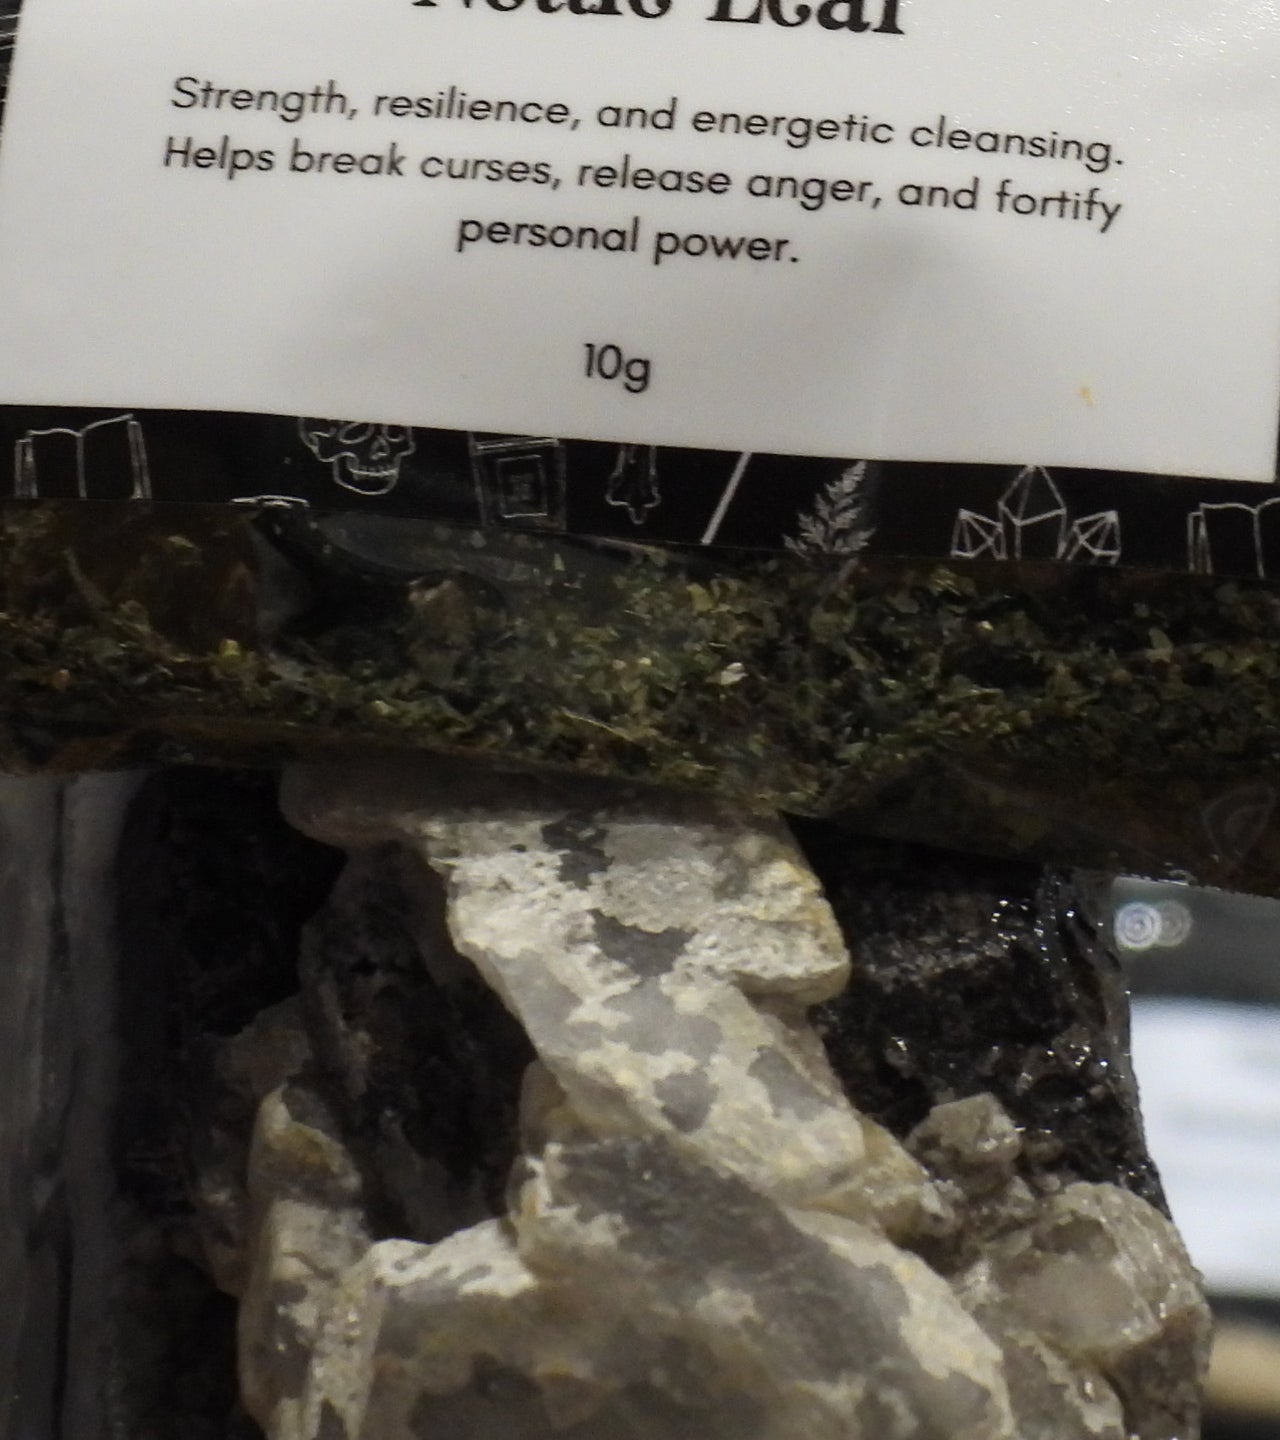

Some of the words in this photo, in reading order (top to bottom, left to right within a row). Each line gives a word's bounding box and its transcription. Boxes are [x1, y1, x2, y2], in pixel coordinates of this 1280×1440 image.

[170, 76, 359, 123] Strength,
[372, 86, 582, 127] resilience,
[596, 98, 678, 133] and
[690, 107, 896, 151] energetic
[909, 115, 1125, 173] cleansing.
[162, 134, 276, 181] Helps
[288, 136, 407, 178] break
[419, 154, 564, 192] curses,
[577, 154, 733, 197] release
[745, 170, 883, 212] anger,
[897, 176, 980, 213] and
[993, 178, 1124, 235] fortify
[455, 214, 641, 255] personal
[652, 230, 801, 266] power.
[582, 342, 652, 394] 10g
